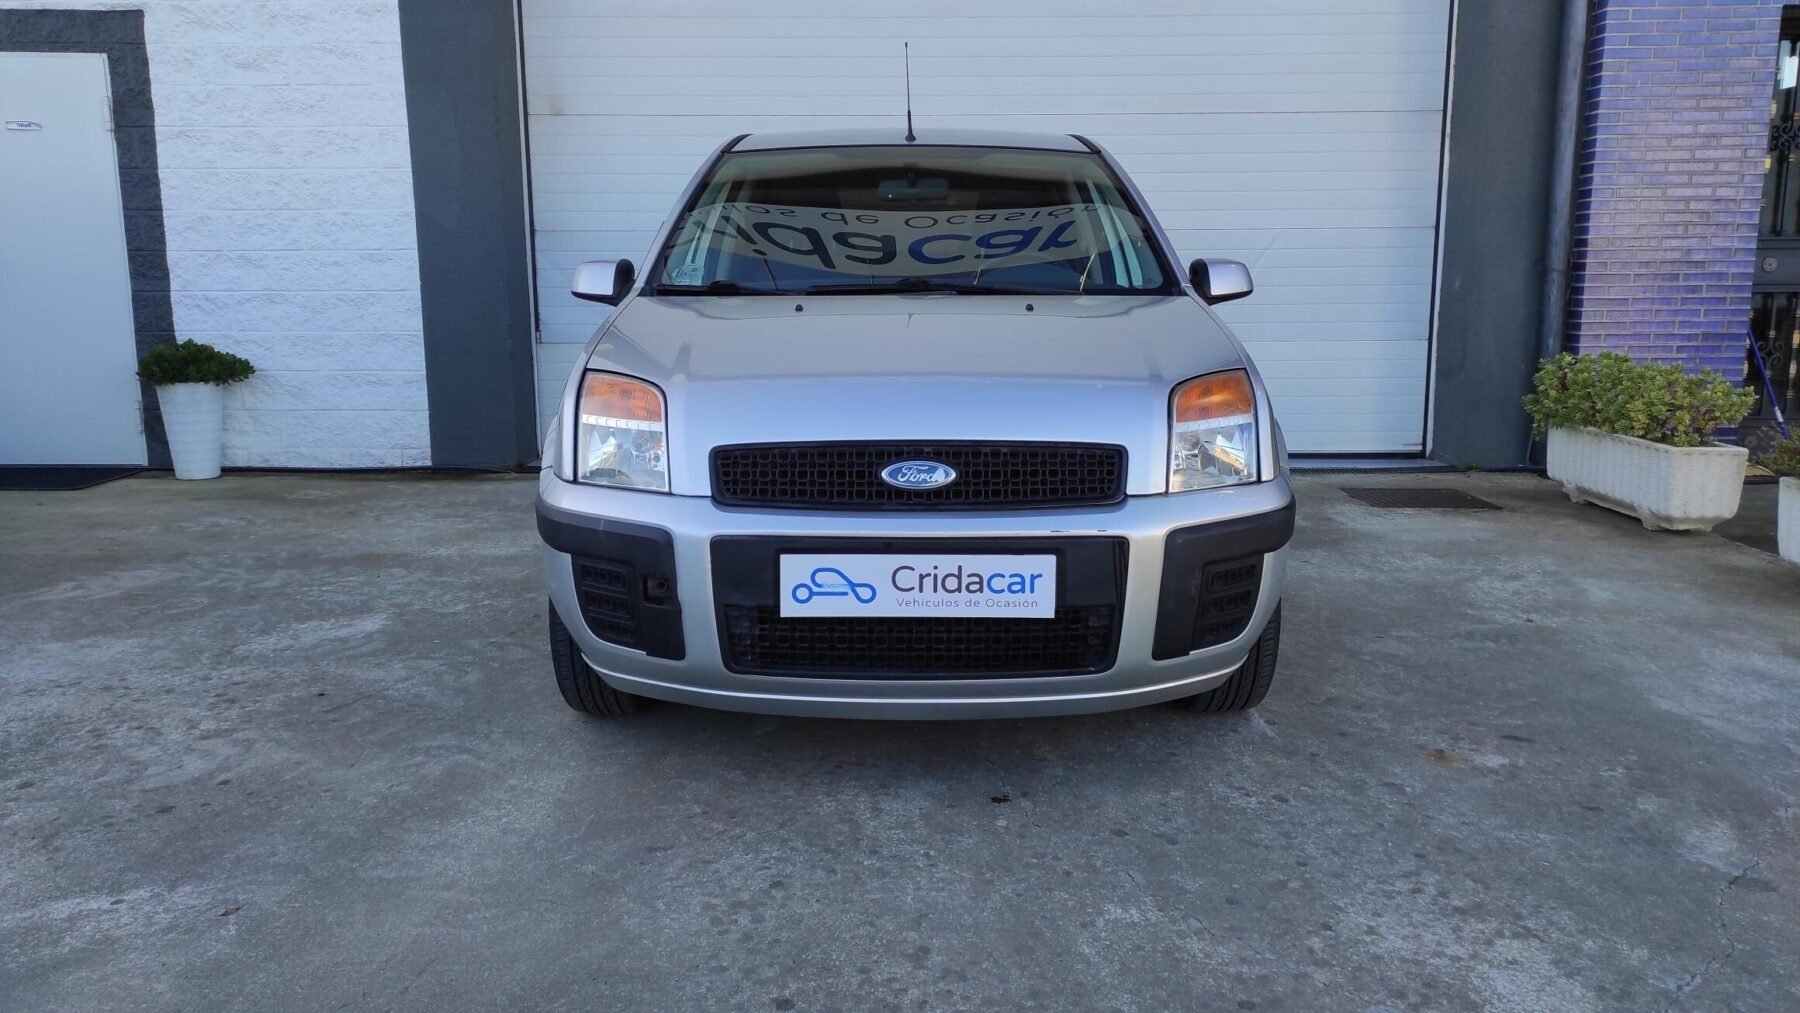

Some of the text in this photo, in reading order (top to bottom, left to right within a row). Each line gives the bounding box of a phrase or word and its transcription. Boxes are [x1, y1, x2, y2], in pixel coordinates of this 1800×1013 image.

[898, 465, 938, 482] Ford
[891, 565, 1044, 594] Cridacar
[964, 598, 980, 608] de
[985, 598, 1038, 608] Ocasión
